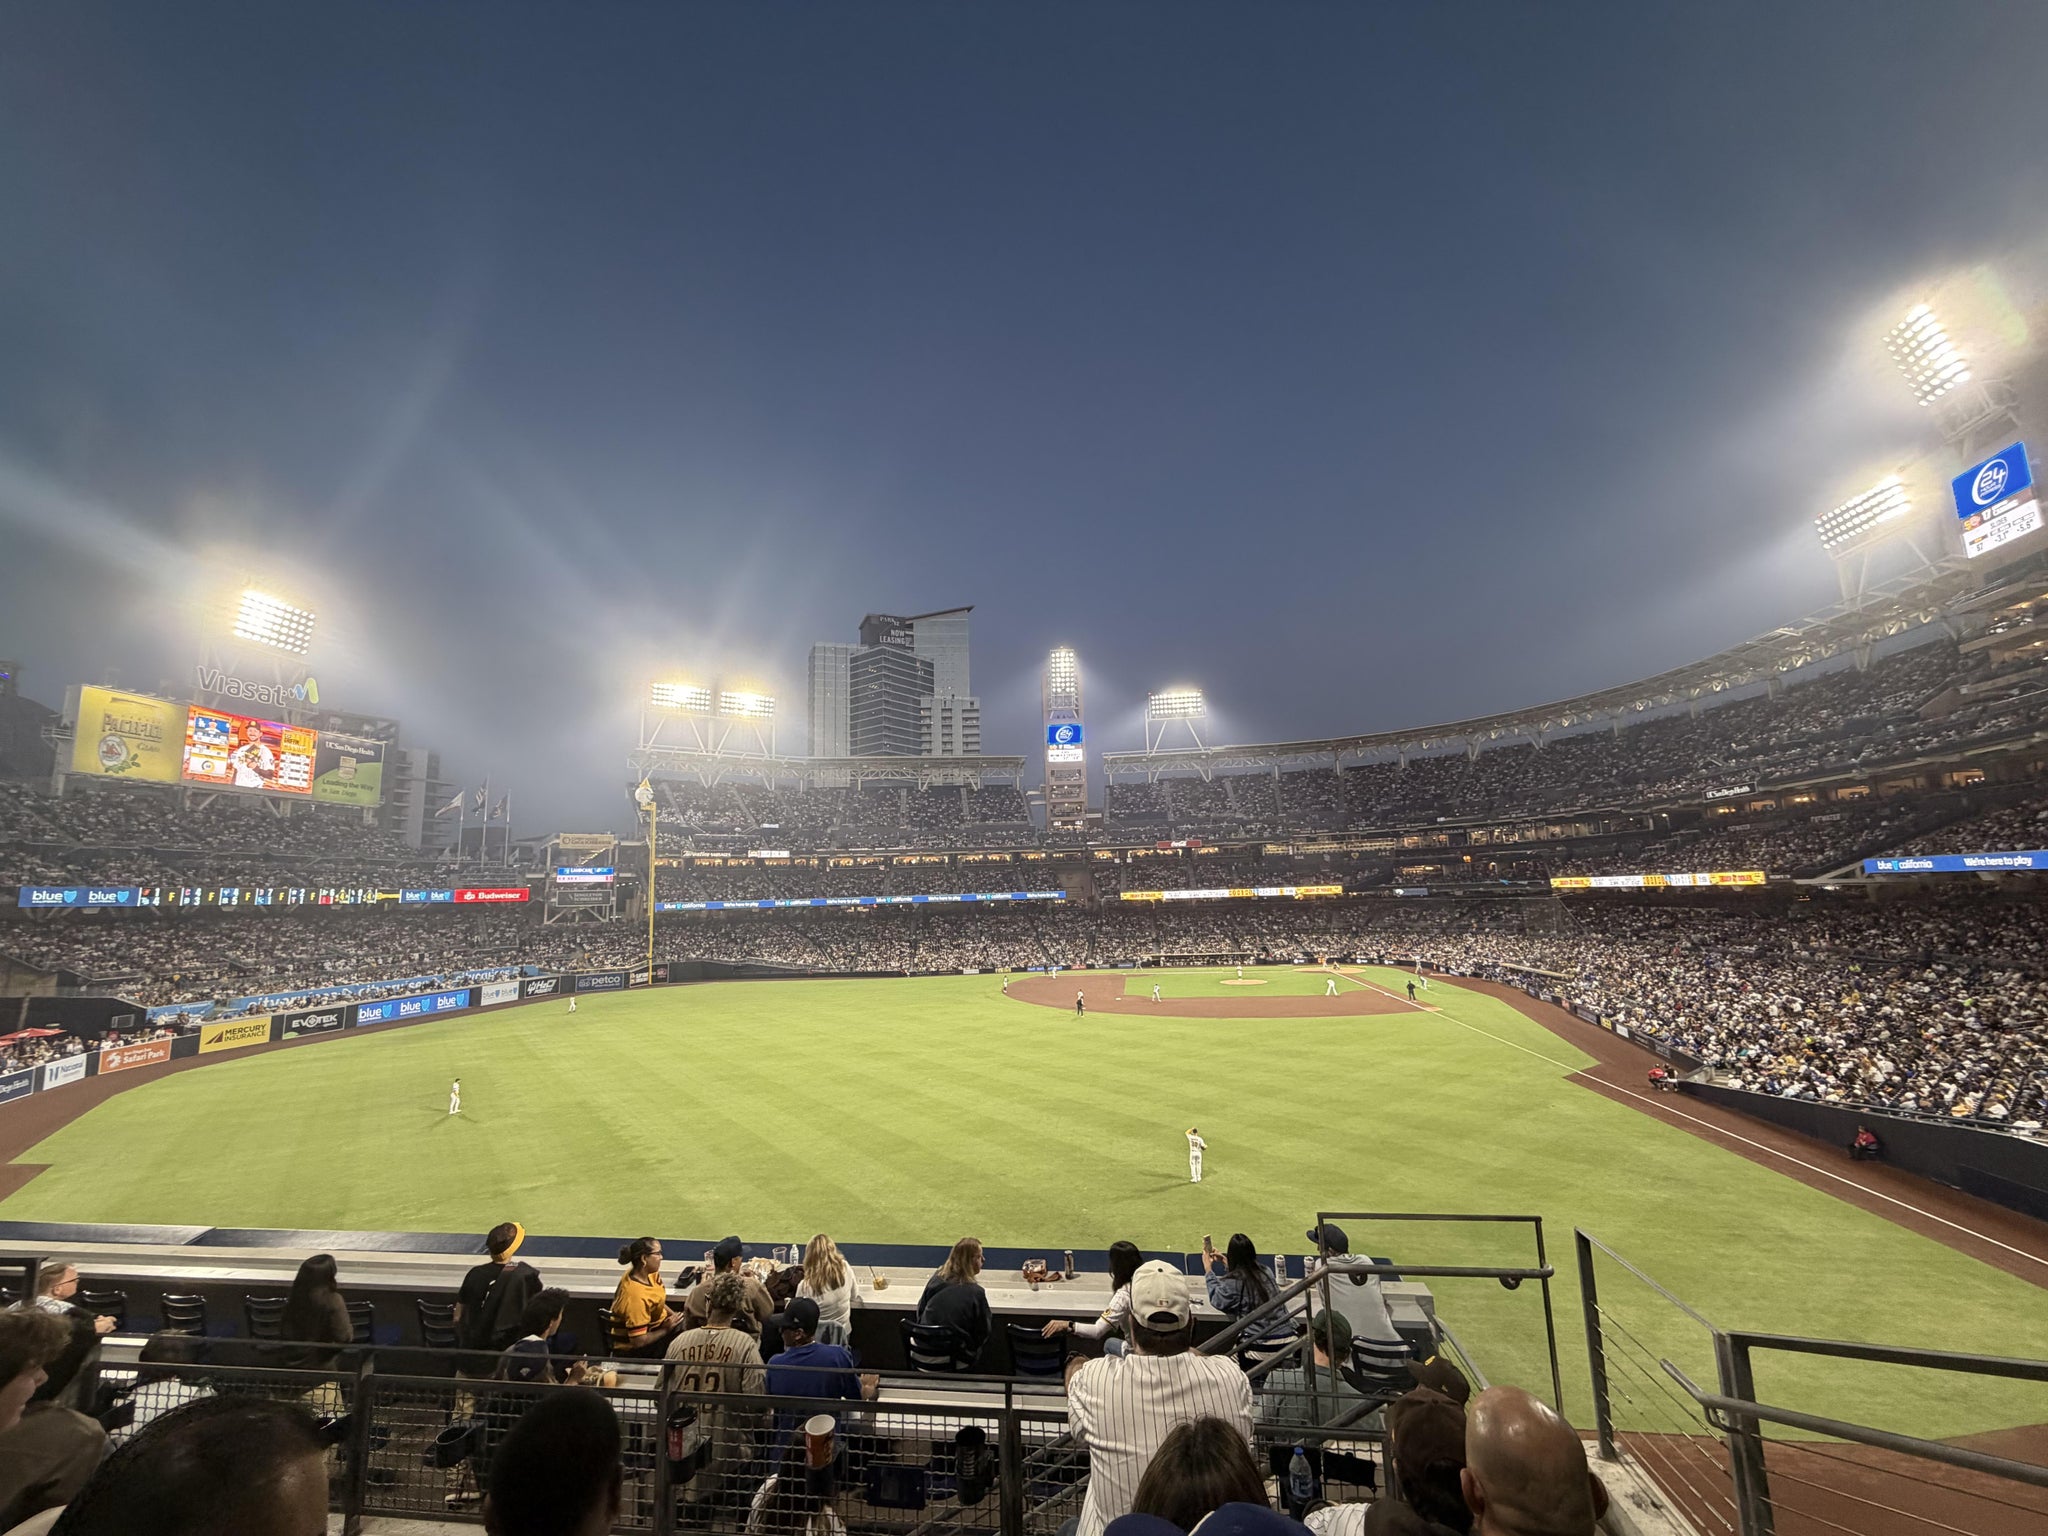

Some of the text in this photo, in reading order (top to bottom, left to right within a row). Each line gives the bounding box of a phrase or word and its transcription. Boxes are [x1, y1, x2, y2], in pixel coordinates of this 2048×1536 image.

[1980, 467, 2006, 488] 24
[880, 636, 905, 645] LEASING
[197, 665, 286, 707] Viasat
[358, 747, 375, 756] Health
[322, 779, 348, 788] Leading
[1877, 859, 1933, 870] blue california
[1964, 855, 2033, 867] We're here to play
[32, 891, 63, 900] blue
[88, 891, 117, 900] blue
[155, 888, 160, 897] 1
[168, 892, 176, 901] F
[208, 892, 215, 901] F
[245, 892, 251, 901] F
[279, 892, 285, 901] F
[310, 892, 316, 901] F
[152, 897, 160, 905] 4
[591, 976, 621, 987] petco
[437, 996, 457, 1006] blue
[401, 1001, 421, 1012] blue
[359, 1007, 382, 1019] blue
[291, 1013, 338, 1028] EVOTEK
[225, 1023, 266, 1036] MERCURY
[224, 1030, 266, 1041] INSURANCE
[123, 1049, 166, 1064] Safari Park
[61, 1061, 83, 1073] National
[681, 1343, 732, 1363] TATIS JR
